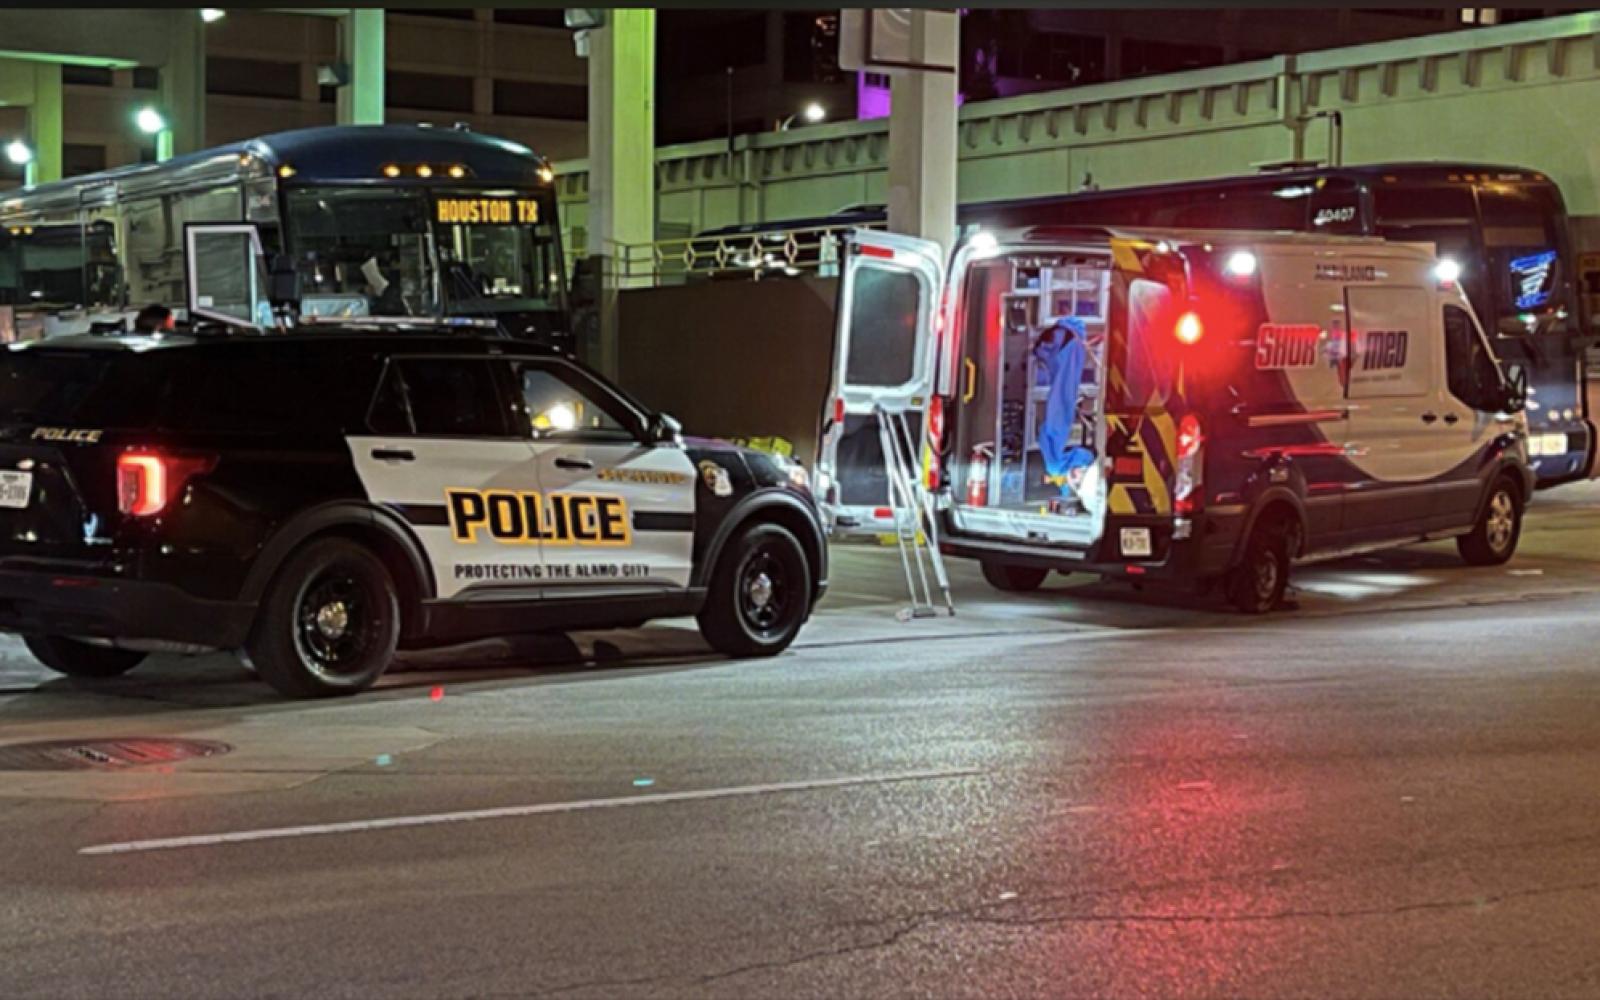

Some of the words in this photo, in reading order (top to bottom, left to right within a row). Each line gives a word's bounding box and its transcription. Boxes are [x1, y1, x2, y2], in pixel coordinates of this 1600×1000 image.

[437, 199, 511, 222] HOUSTON
[516, 199, 538, 222] TX
[31, 427, 103, 443] POLICE
[445, 487, 634, 546] POLICE
[454, 564, 542, 579] PROTECTING
[547, 564, 571, 578] THE
[575, 564, 619, 577] ALAMO
[622, 564, 650, 577] CITY
